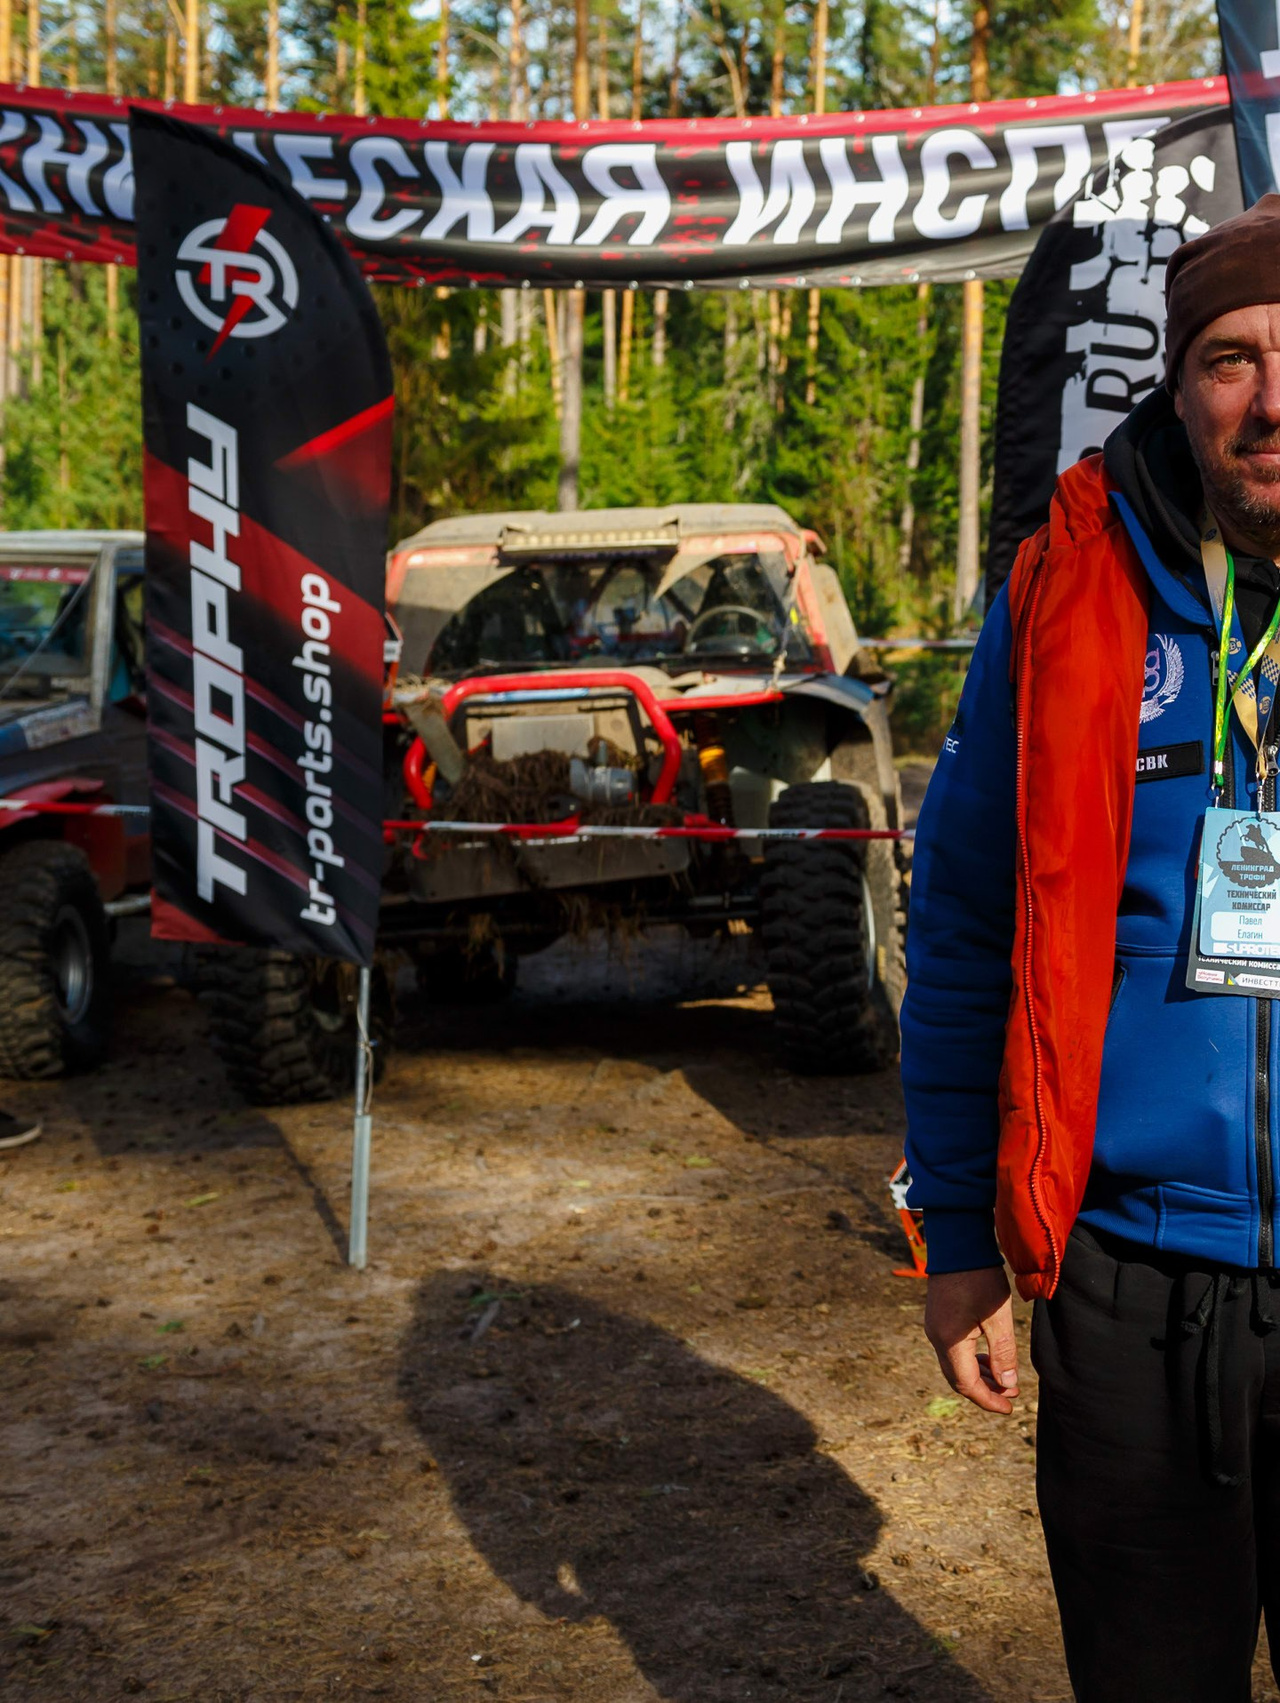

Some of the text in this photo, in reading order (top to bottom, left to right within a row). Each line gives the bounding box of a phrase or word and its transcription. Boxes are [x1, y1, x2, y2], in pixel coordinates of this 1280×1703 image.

[186, 402, 248, 902] TROPHY
[293, 572, 345, 926] tr-parts.shop
[1230, 863, 1275, 874] ЛЕНИНГРАД
[1239, 873, 1266, 881] ТРОФИ
[1226, 889, 1277, 900] ТЕХНИЧЕСКИЙ
[1231, 901, 1271, 912] КОМИССАР
[1239, 915, 1263, 926] Павел
[1237, 929, 1263, 940] Елагин
